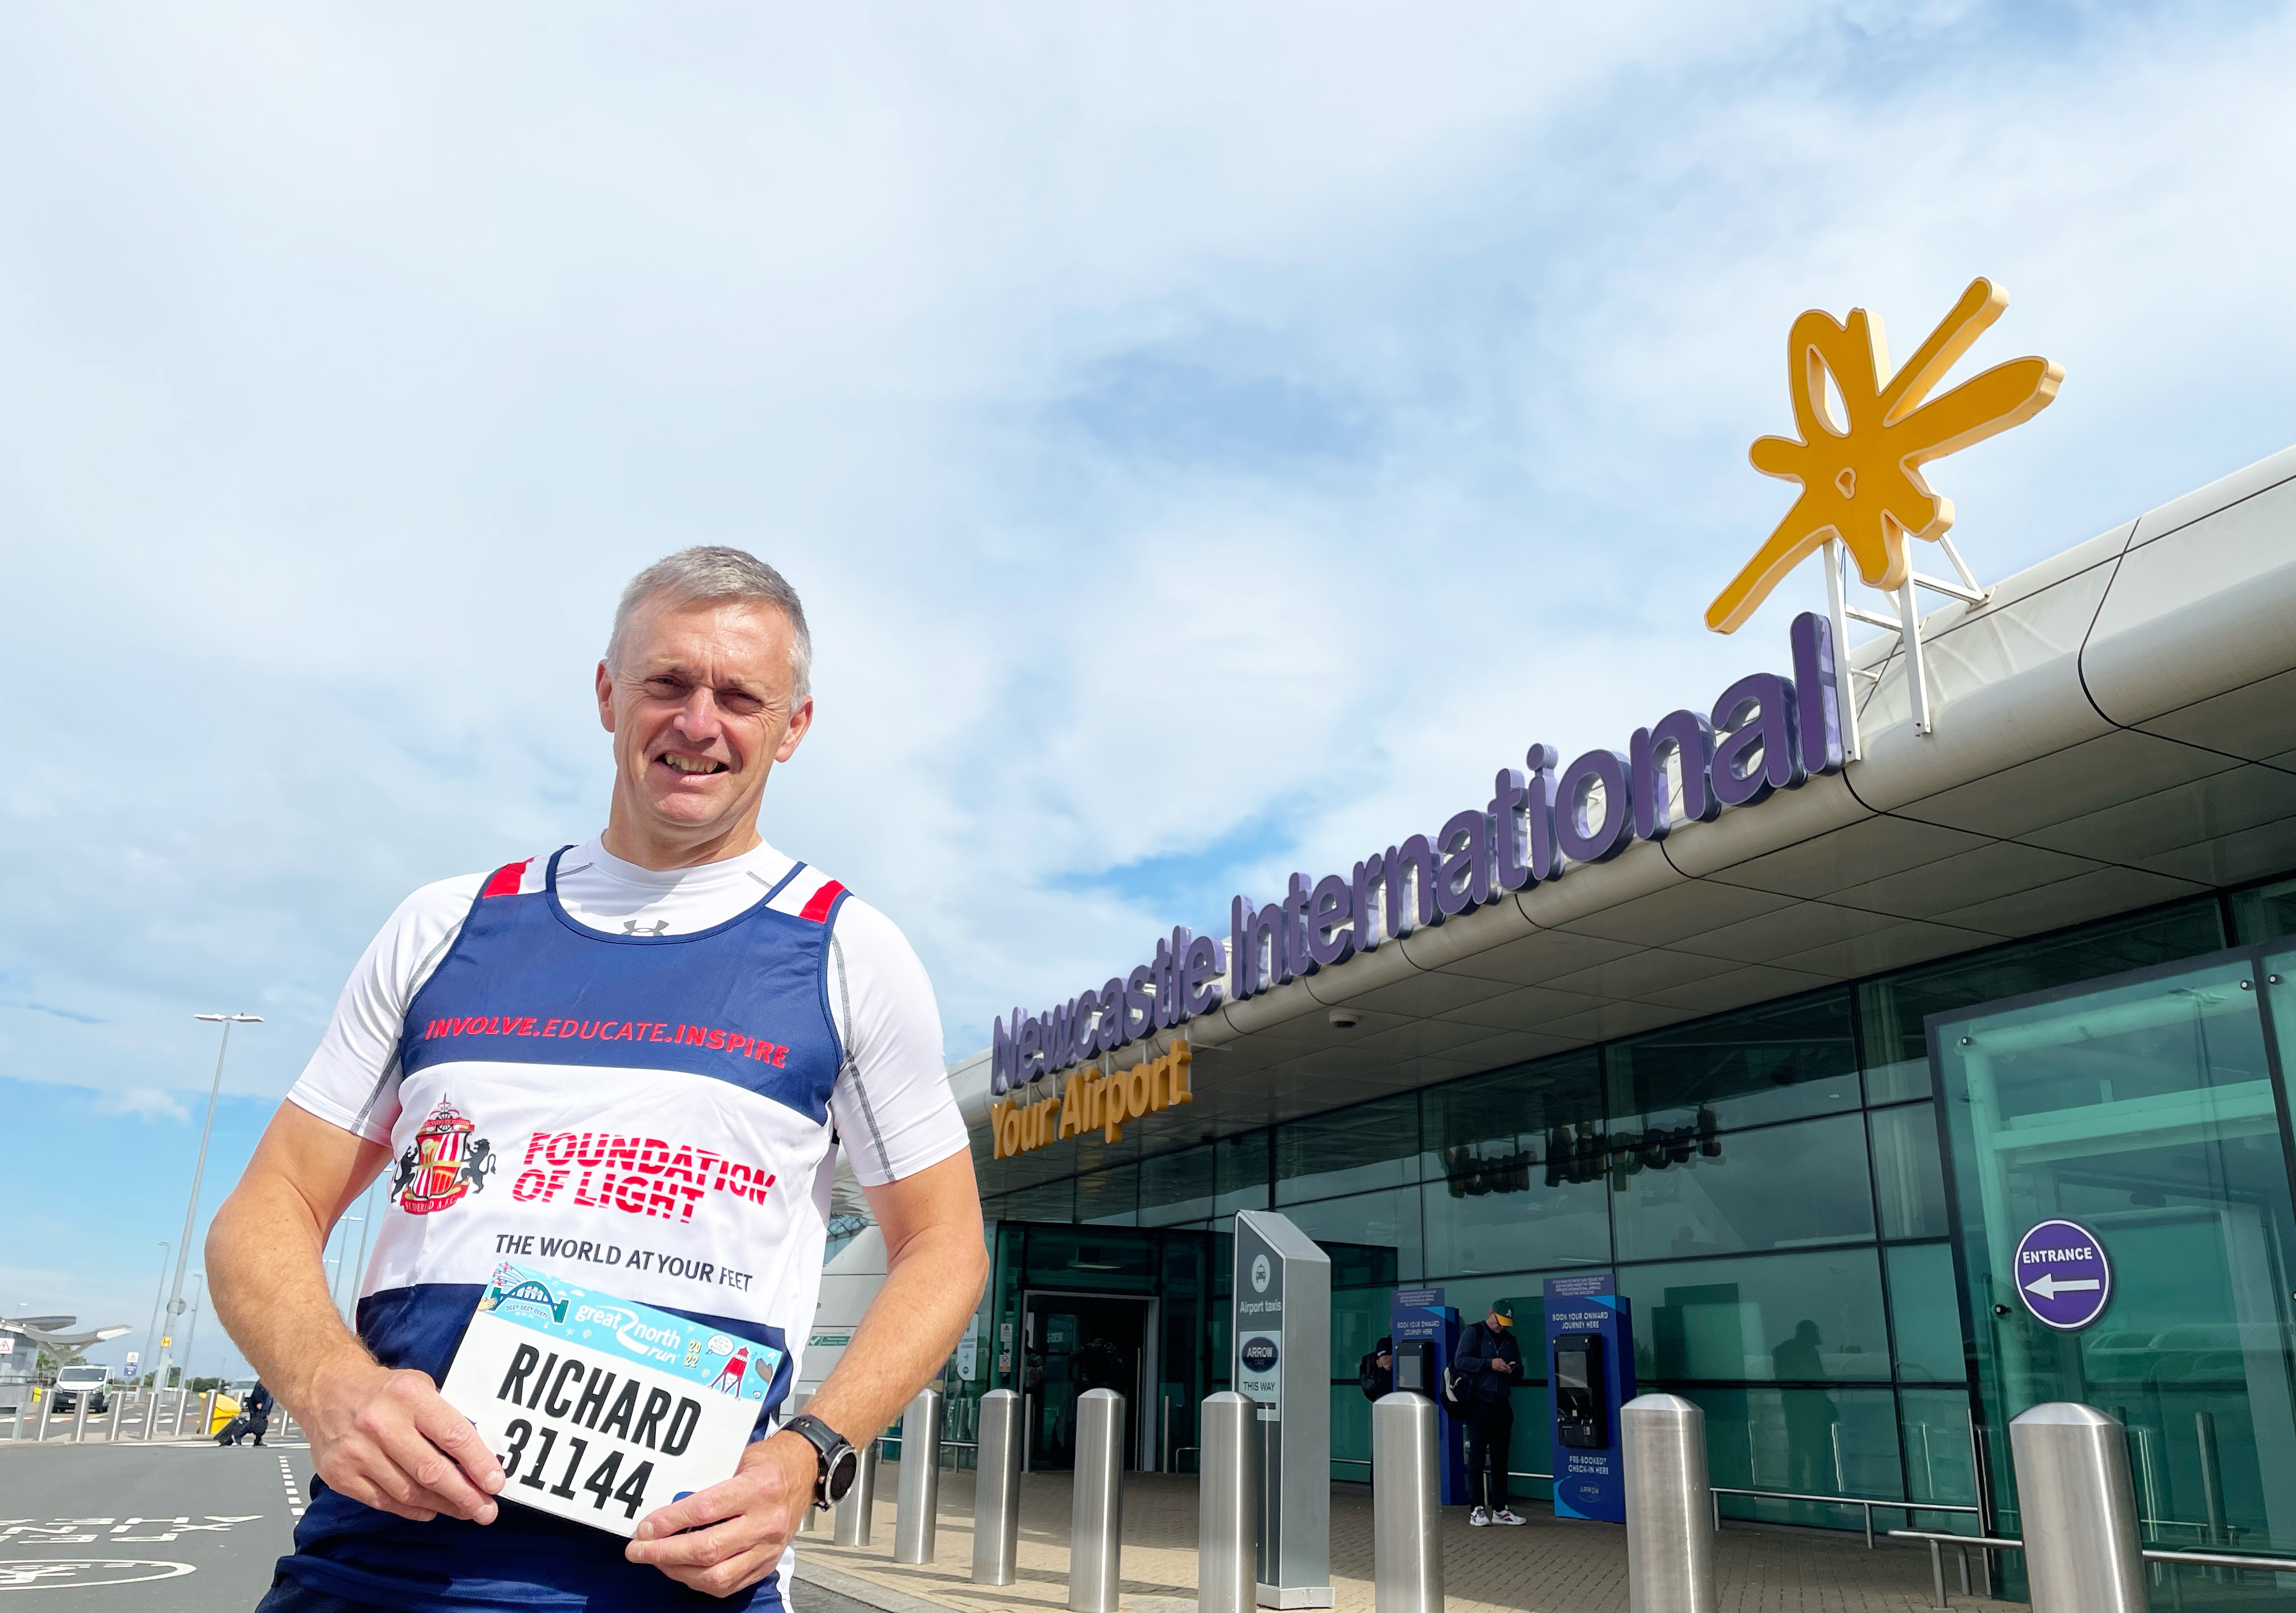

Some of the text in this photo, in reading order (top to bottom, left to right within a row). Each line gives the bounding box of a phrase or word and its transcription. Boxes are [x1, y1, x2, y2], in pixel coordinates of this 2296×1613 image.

[991, 612, 1842, 1096] Newcastle International
[991, 1039, 1192, 1160] Your Airport
[523, 1132, 776, 1206] FOUNDATION
[512, 1169, 705, 1224] OF LIGHT
[495, 1234, 753, 1292] THE WORLD AT YOUR FEET
[2022, 1247, 2093, 1264] ENTRANCE
[1240, 1300, 1281, 1315] Airport taxis
[1584, 1312, 1608, 1320] ONWARD
[575, 1304, 622, 1329] great
[634, 1321, 681, 1350] north
[647, 1346, 677, 1365] run
[688, 1340, 702, 1353] 20
[1247, 1347, 1273, 1358] ARROW
[684, 1354, 698, 1368] 22
[1244, 1382, 1276, 1391] THIS WAY
[497, 1342, 701, 1456] RICHARD
[1568, 1464, 1594, 1473] CHECK-IN
[1569, 1455, 1606, 1465] PRE-BOOKED?
[497, 1419, 654, 1520] 31144
